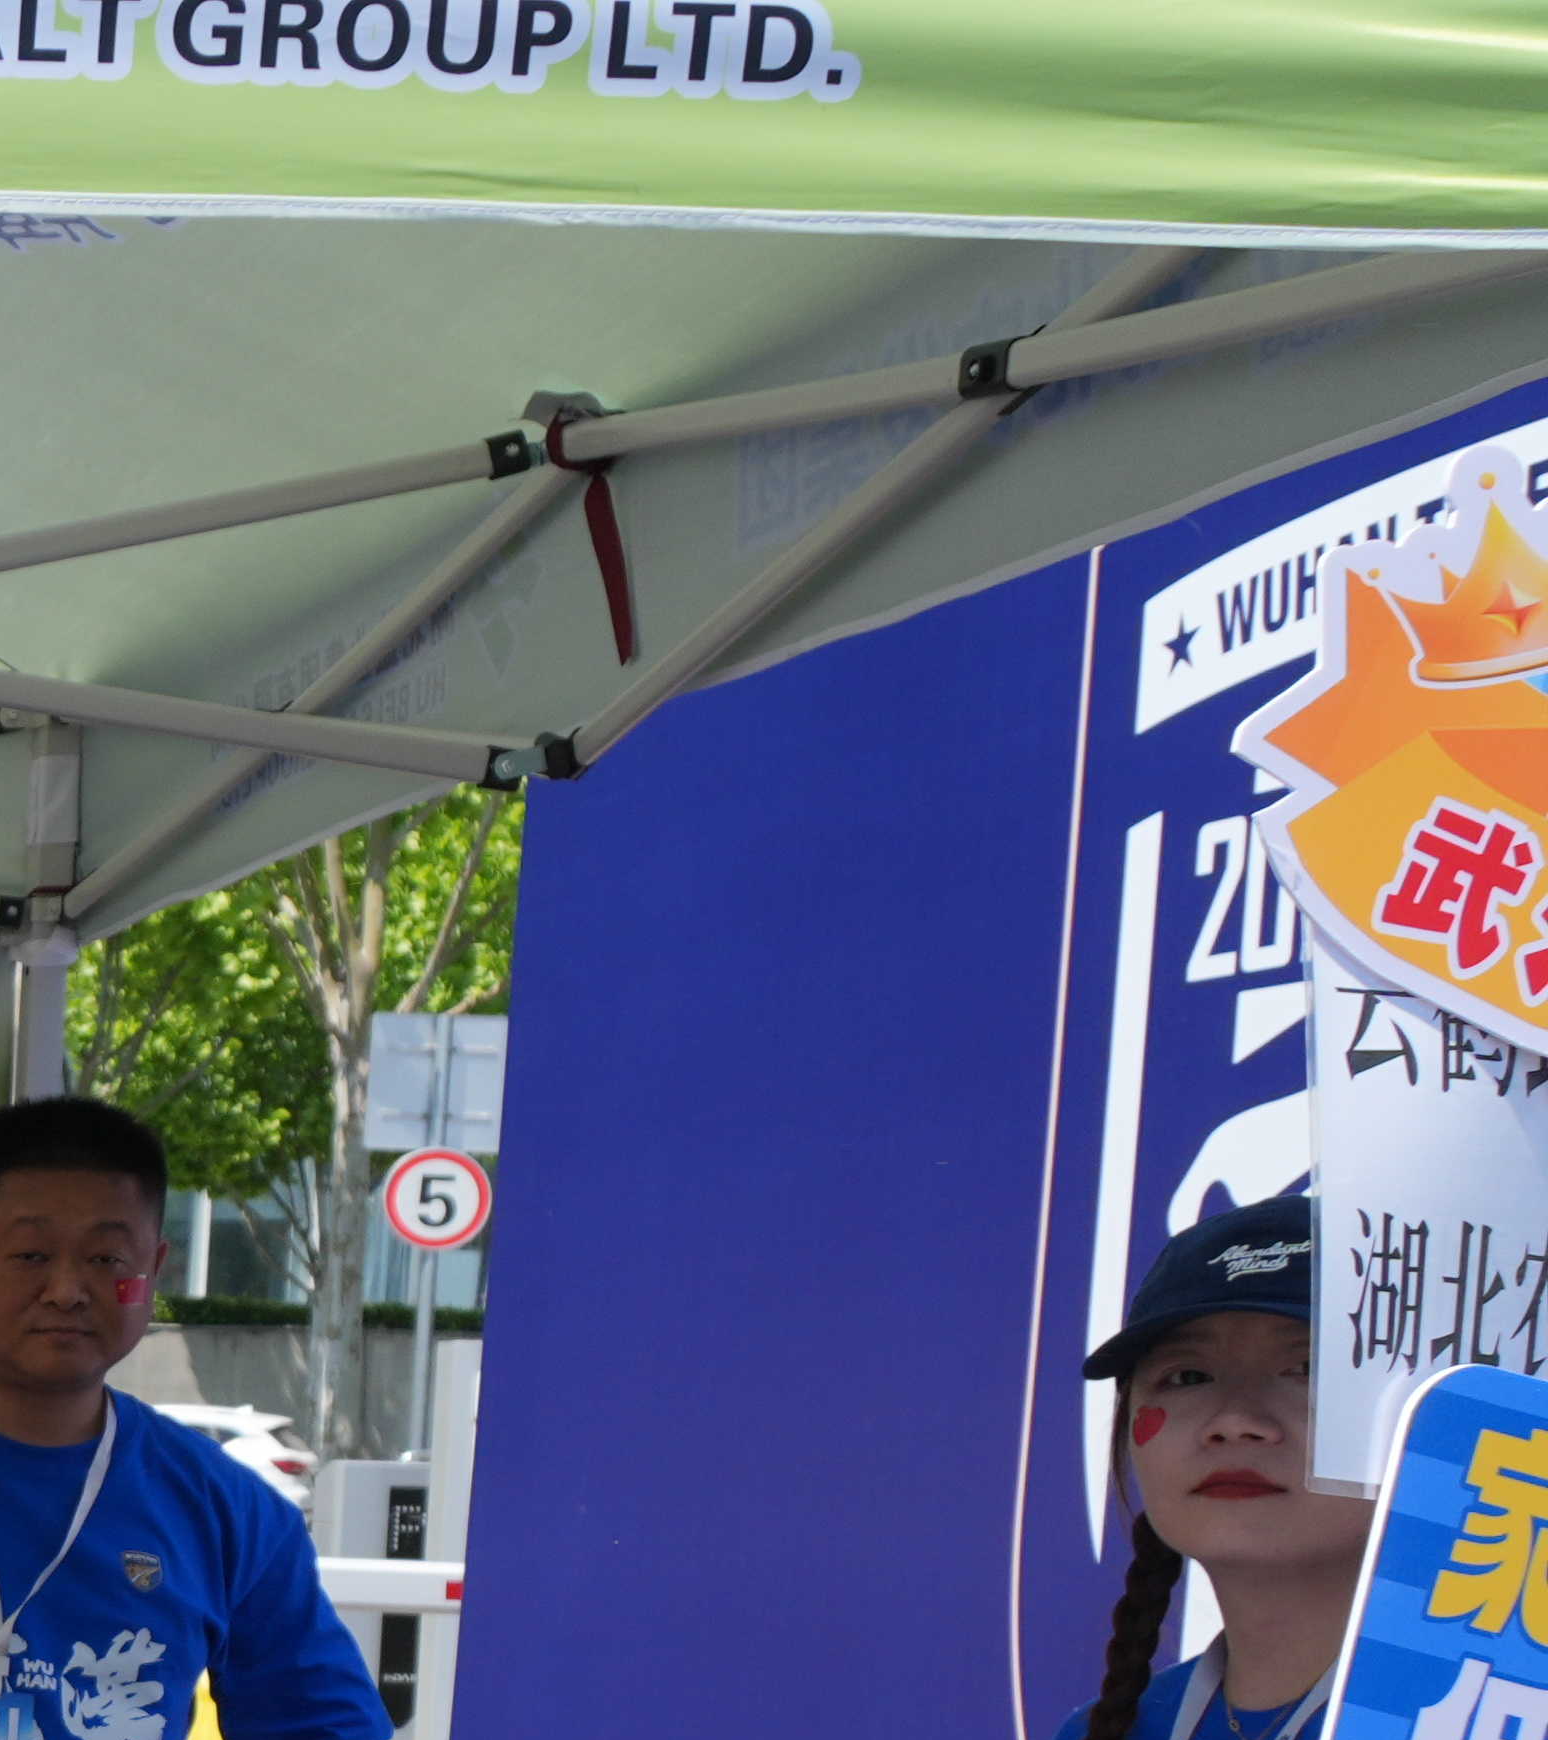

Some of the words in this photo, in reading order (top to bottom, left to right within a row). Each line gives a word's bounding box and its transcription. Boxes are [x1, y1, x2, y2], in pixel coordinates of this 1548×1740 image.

[174, 0, 572, 76] GROUP
[607, 2, 842, 84] LTD.
[416, 1173, 454, 1228] 5
[16, 1673, 57, 1691] HAN
[23, 1658, 54, 1676] WU
